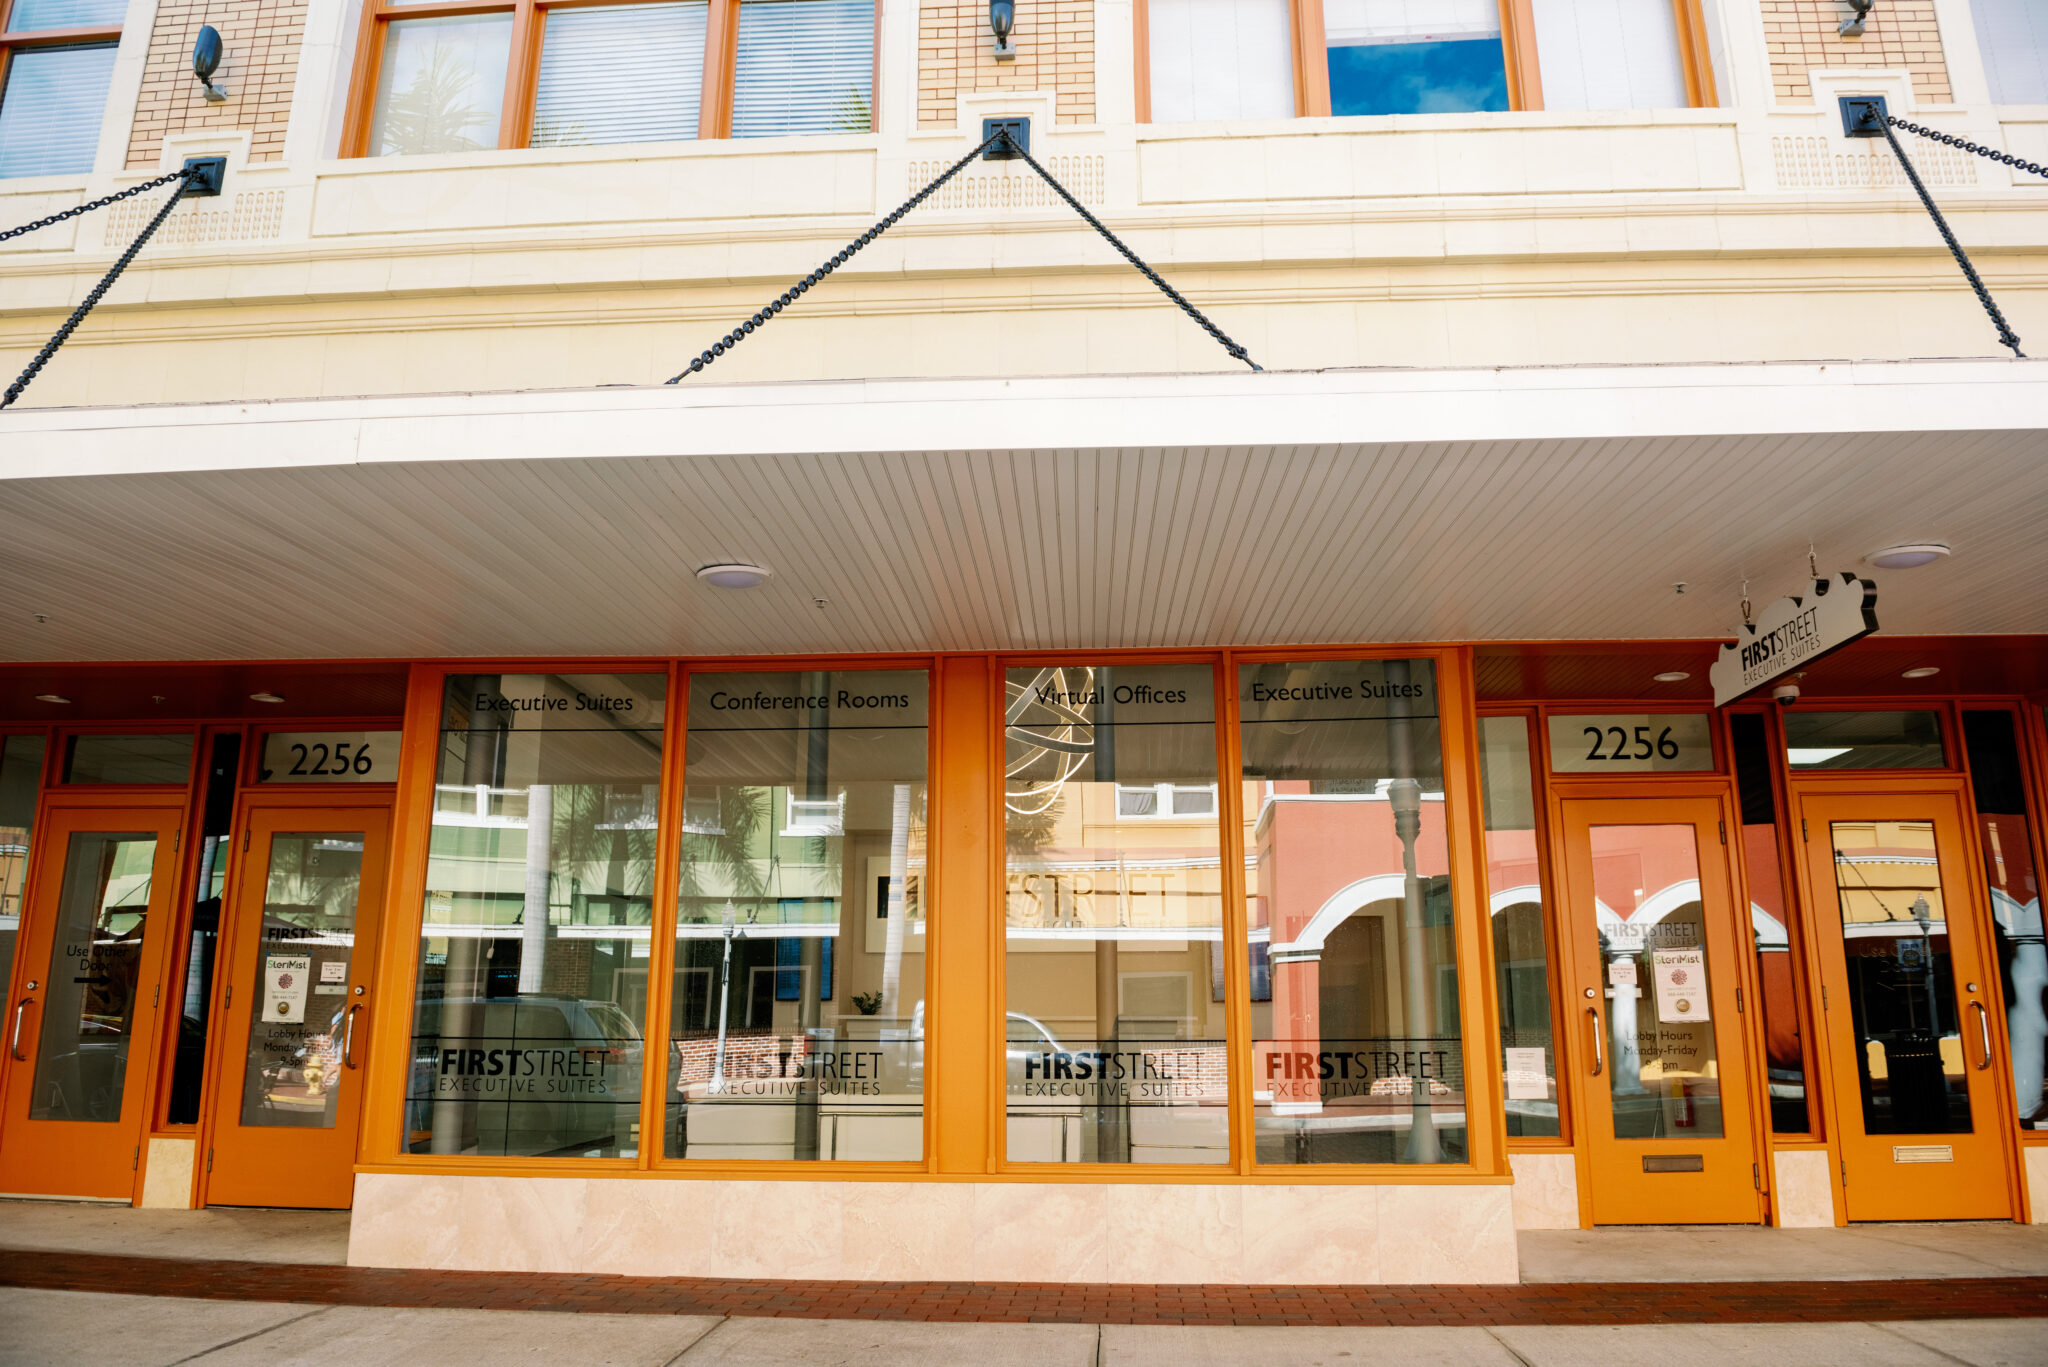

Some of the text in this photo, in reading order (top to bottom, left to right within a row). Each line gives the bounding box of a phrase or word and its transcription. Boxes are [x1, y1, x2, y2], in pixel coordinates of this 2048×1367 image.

[1743, 634, 1821, 686] EXECUTIVE SUITES
[1035, 685, 1186, 705] Virtual Offices
[1252, 679, 1423, 701] Executive Suites
[475, 692, 633, 711] Executive Suites
[710, 690, 909, 710] Conference Rooms
[1583, 726, 1679, 760] 2256
[288, 743, 372, 775] 2256
[67, 944, 129, 957] Use Other
[80, 959, 112, 971] Door
[267, 959, 307, 970] SteriMist
[1655, 954, 1700, 965] SteriMist
[269, 1029, 296, 1040] Lobby
[1626, 1031, 1693, 1043] Lobby Hours
[1624, 1044, 1698, 1057] Monday-Friday
[439, 1077, 607, 1094] EXECUTIVE SUITES
[707, 1081, 881, 1096] EXECUTIVE SUITES
[1025, 1082, 1205, 1097] EXECUTIVE SUITES
[1266, 1081, 1449, 1097] EXECUTIVE SUTES
